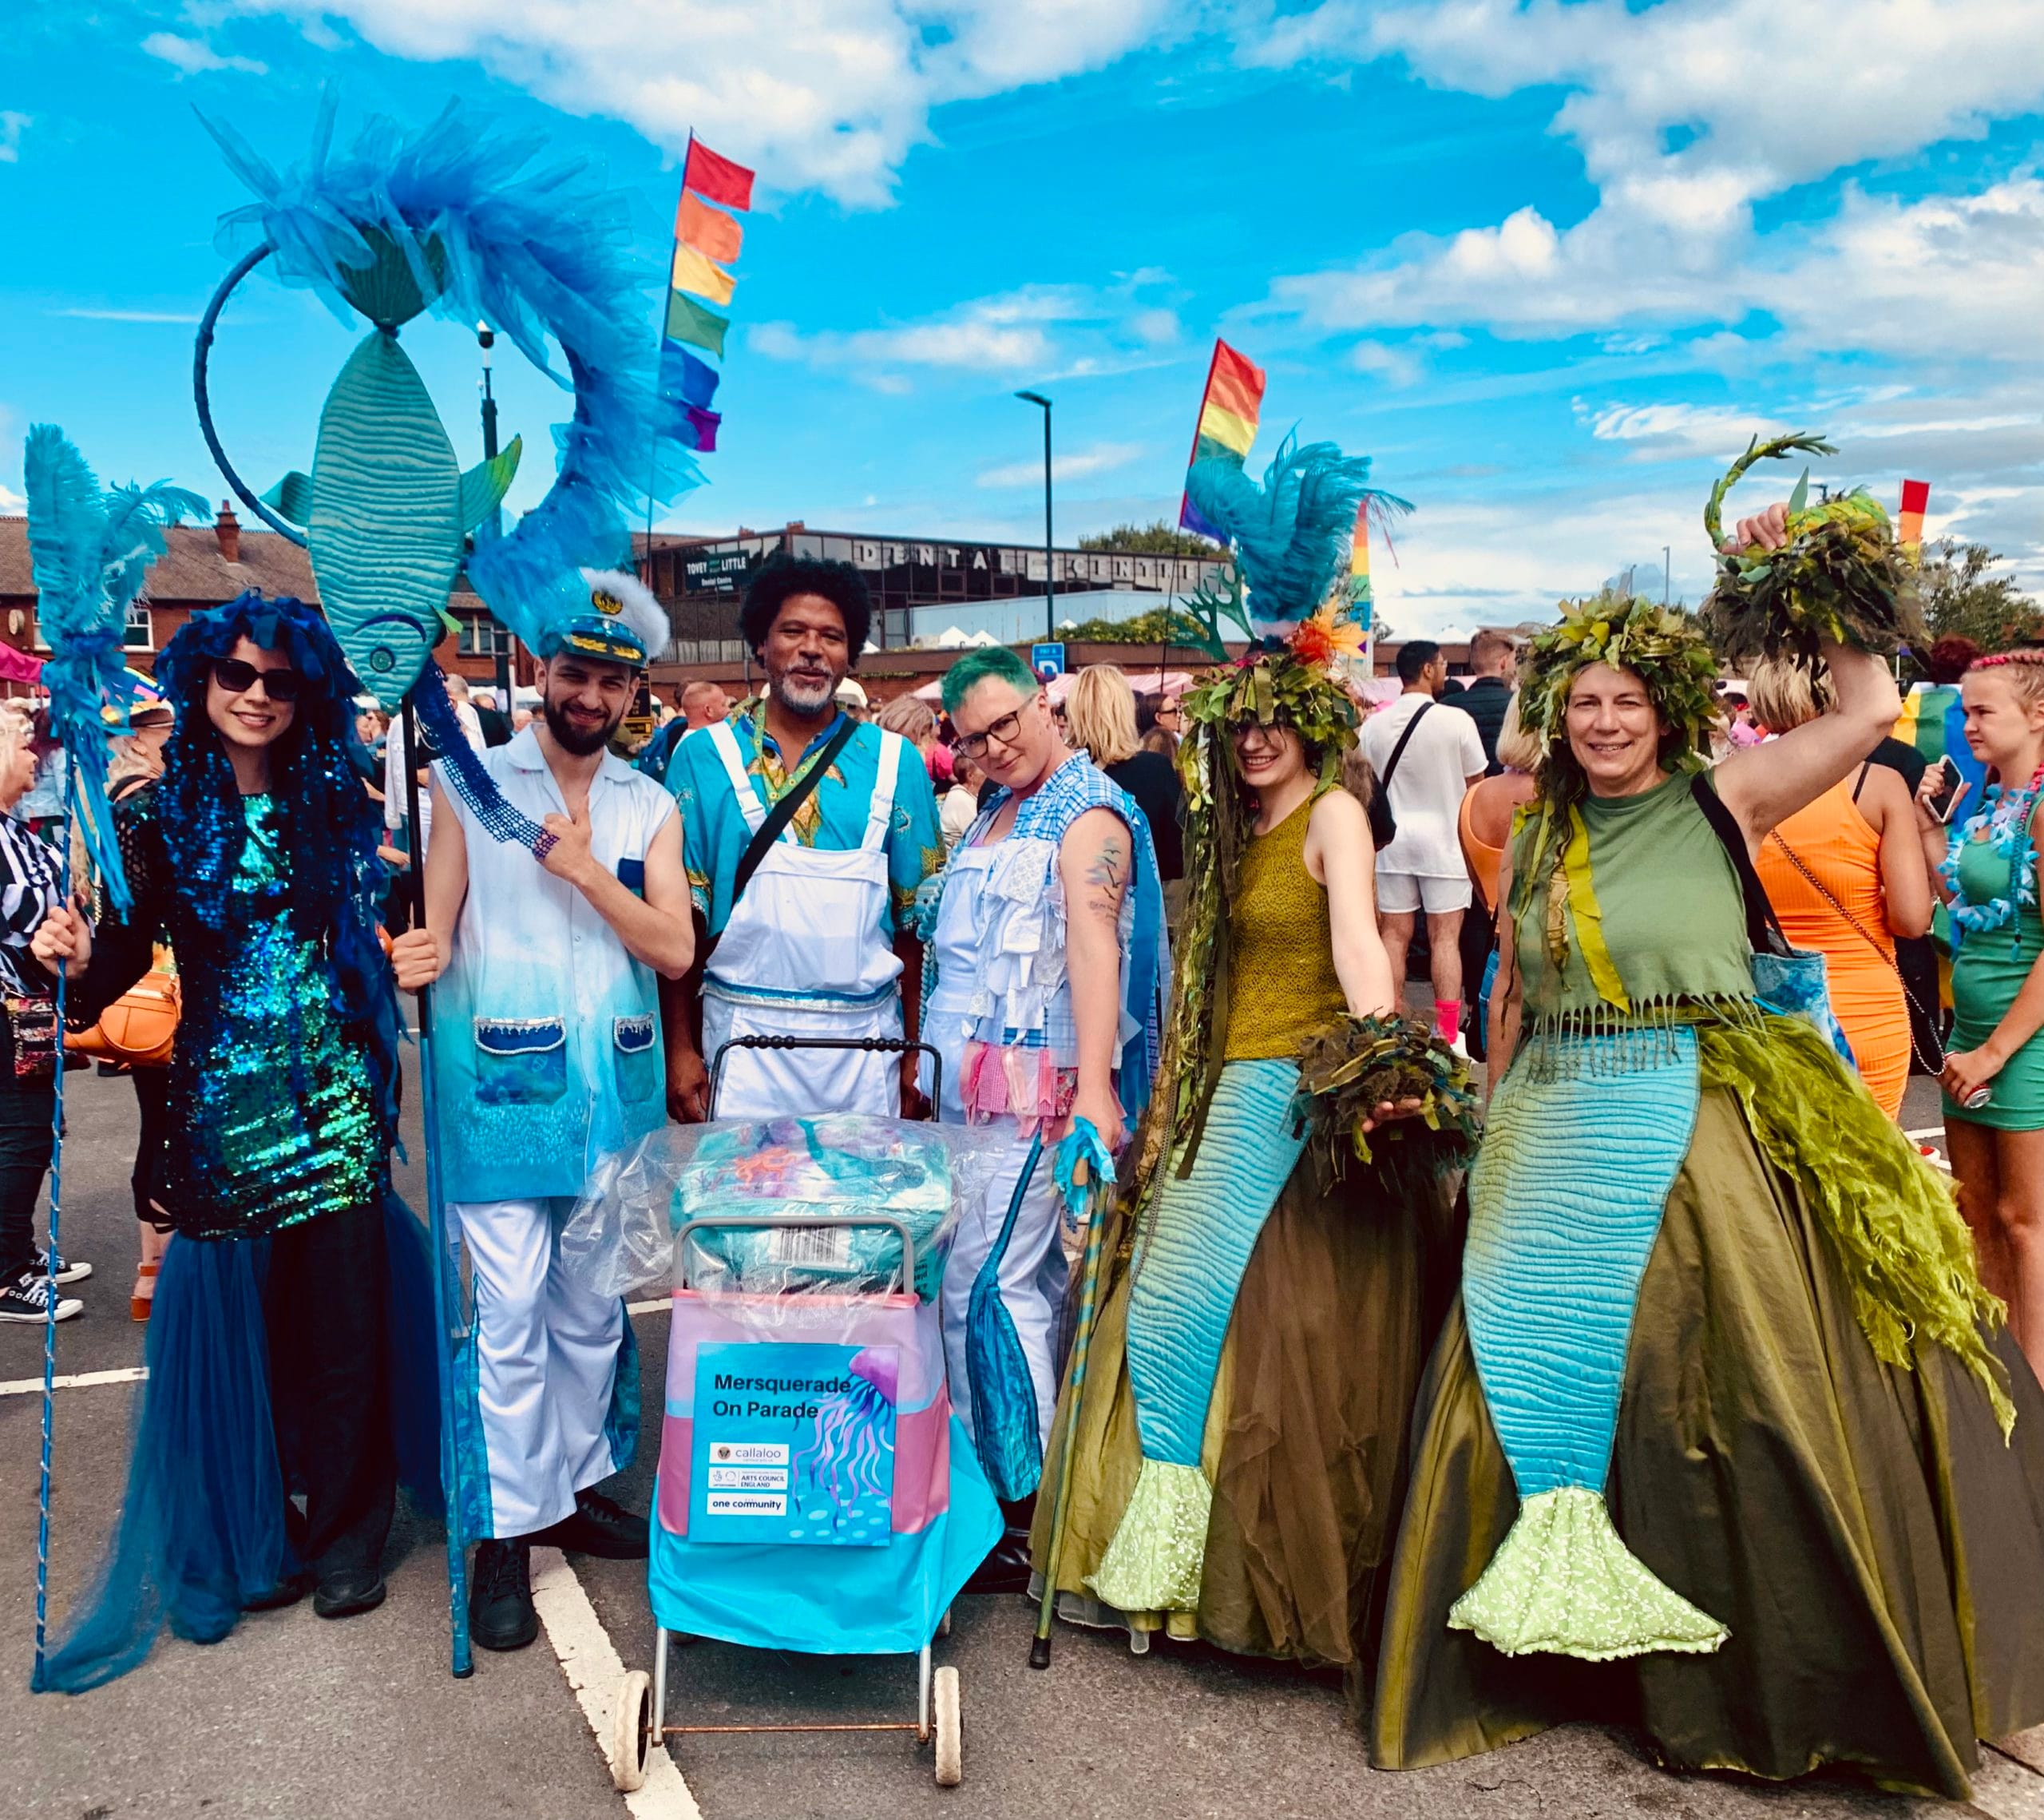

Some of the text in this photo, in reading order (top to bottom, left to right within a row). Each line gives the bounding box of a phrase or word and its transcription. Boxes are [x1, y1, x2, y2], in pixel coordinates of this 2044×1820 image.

[687, 561, 707, 574] TOVEY
[722, 557, 746, 571] LITTLE
[863, 542, 1196, 580] DENTAL CENTRE
[715, 1374, 851, 1395] Mersquerade
[713, 1400, 819, 1419] On Parade
[735, 1447, 781, 1458] callaloo
[732, 1500, 781, 1510] community
